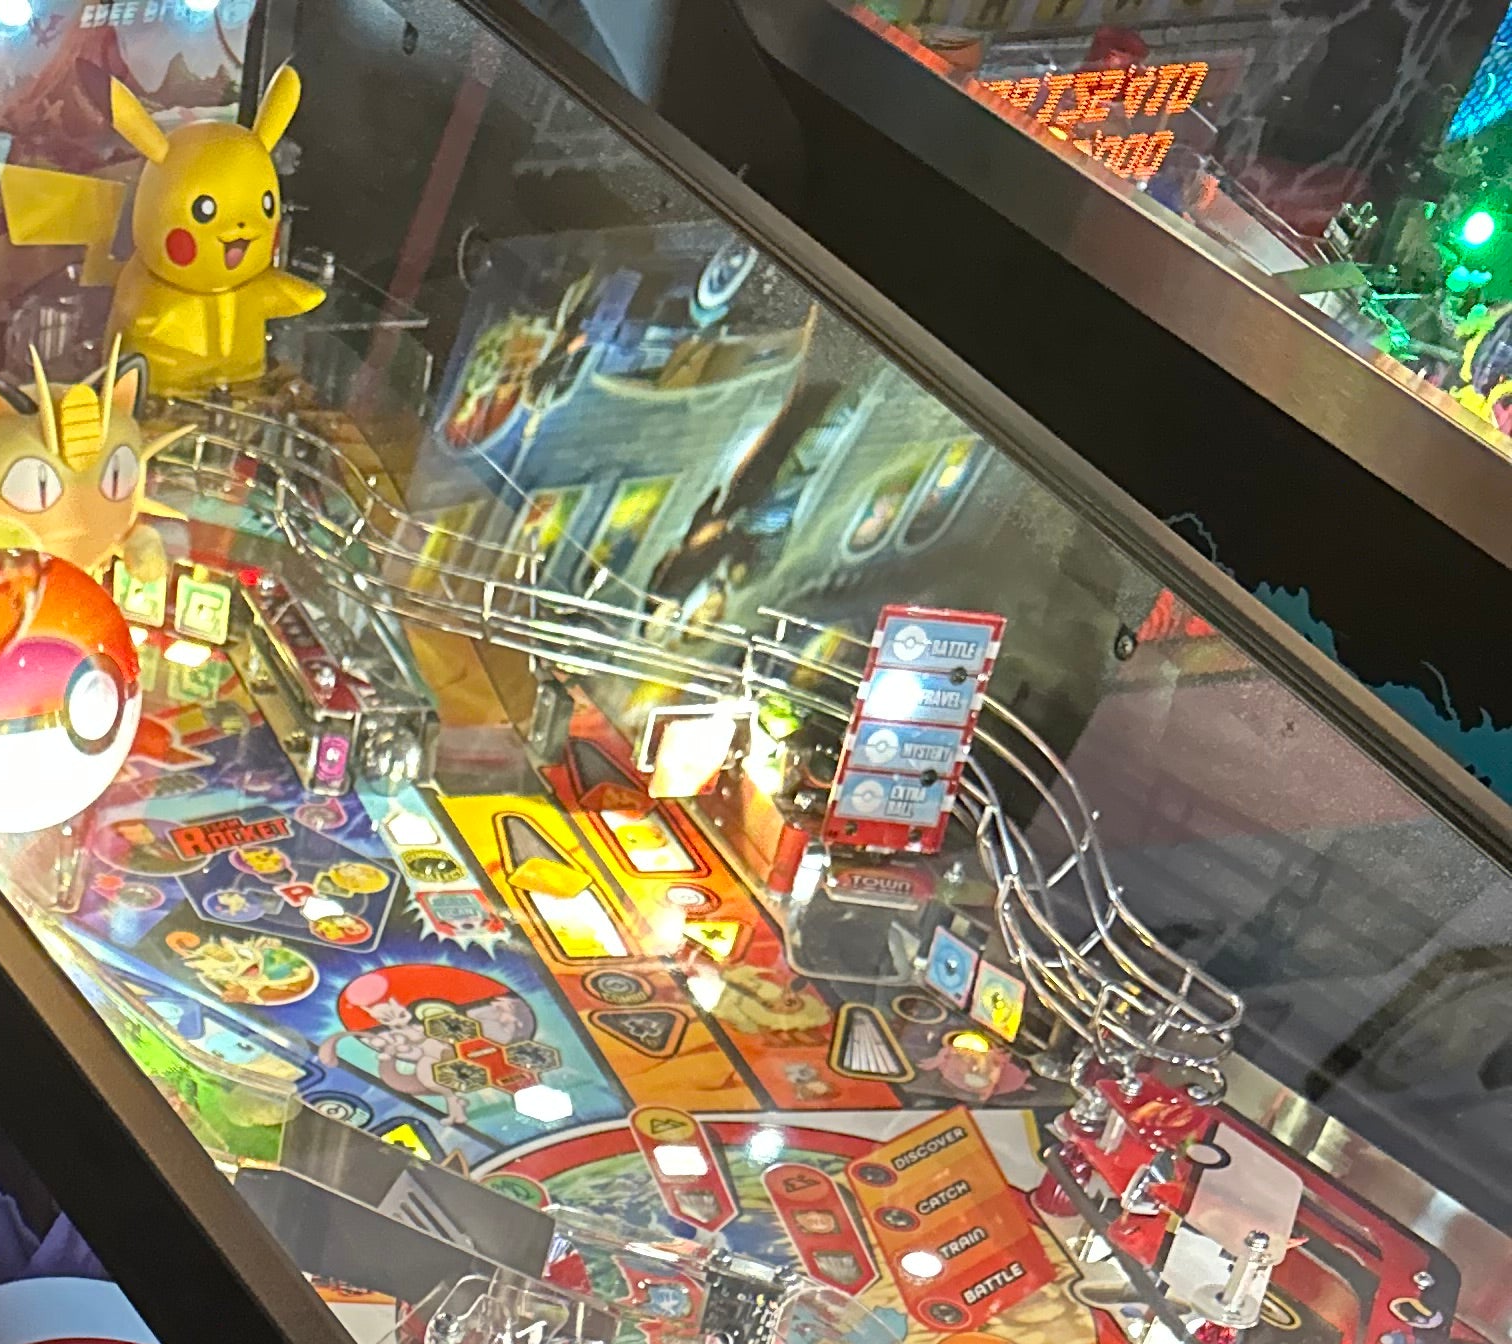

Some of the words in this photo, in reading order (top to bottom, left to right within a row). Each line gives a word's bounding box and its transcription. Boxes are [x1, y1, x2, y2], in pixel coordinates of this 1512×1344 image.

[930, 639, 976, 660] BATTLE
[901, 742, 952, 762] MYSTERY
[889, 785, 928, 804] EXTRA
[886, 800, 915, 818] BALL
[171, 817, 289, 857] ROCKET
[851, 874, 912, 896] TOWN
[894, 1127, 966, 1170] DISCOVER
[918, 1181, 969, 1214] CATCH
[940, 1228, 986, 1259] TRAIN
[963, 1263, 1024, 1304] BATTLE
